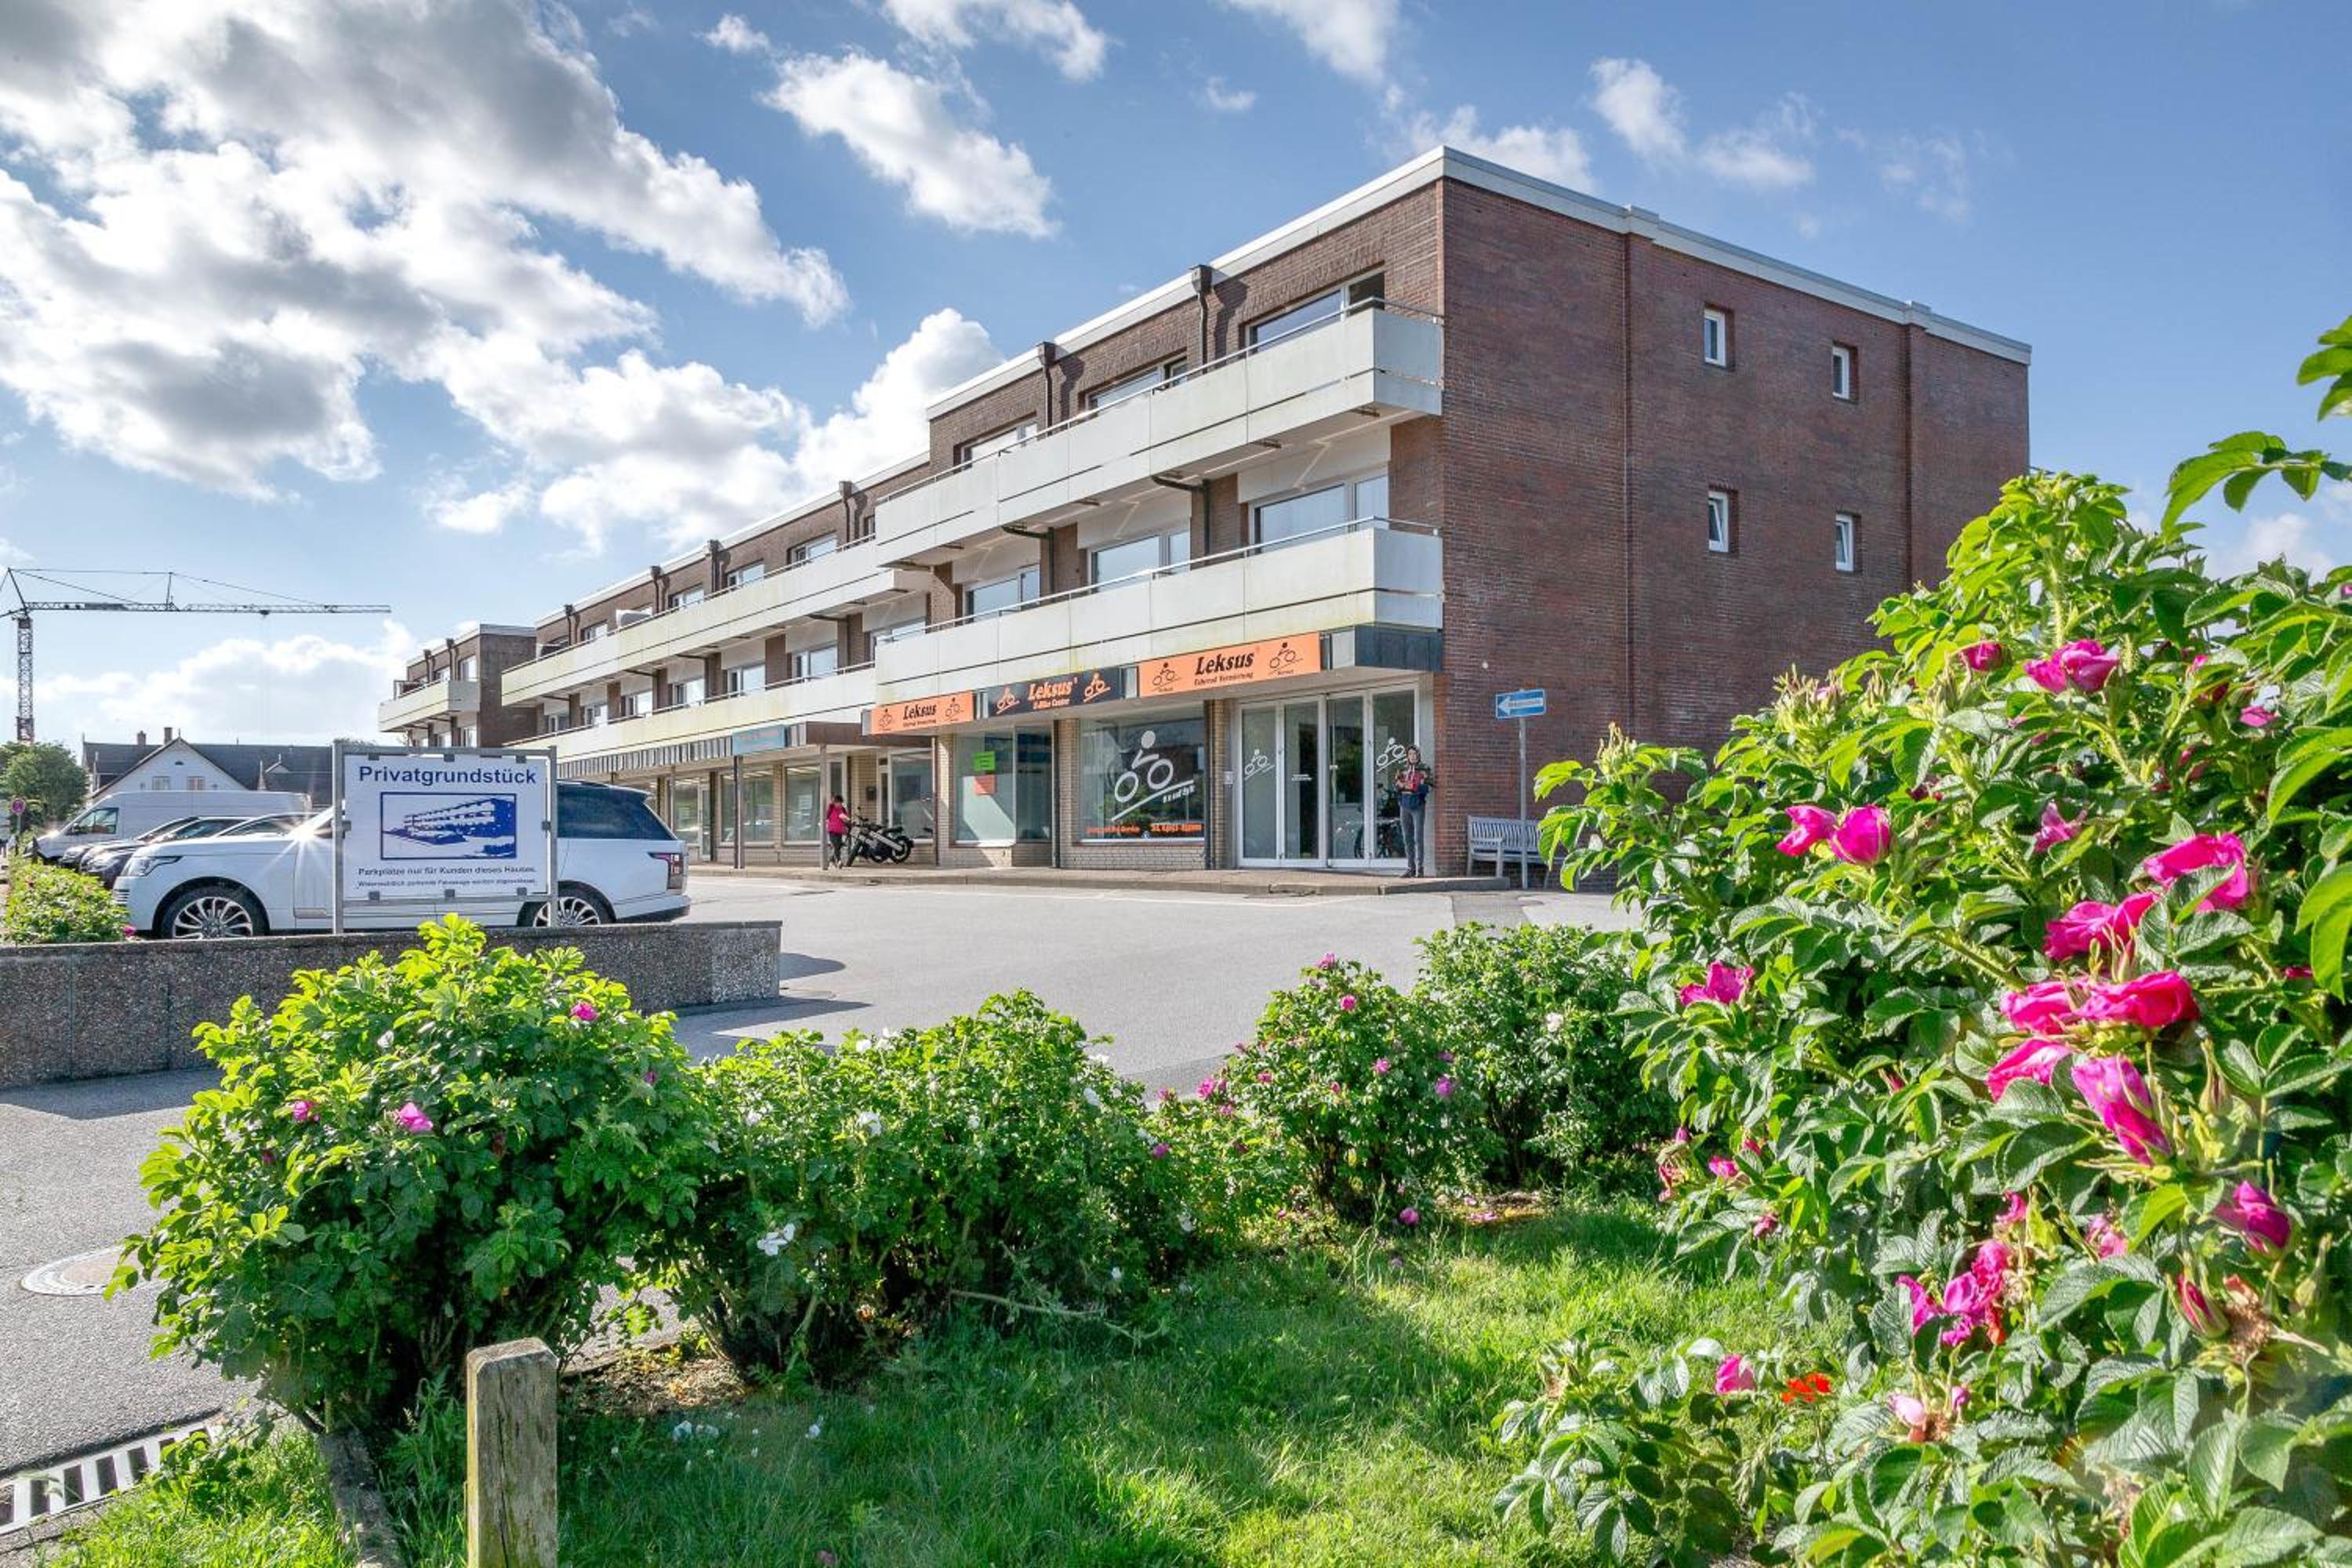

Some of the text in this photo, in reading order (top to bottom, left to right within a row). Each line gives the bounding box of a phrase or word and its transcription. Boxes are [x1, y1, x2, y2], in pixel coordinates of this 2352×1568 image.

[1194, 652, 1254, 675] Leksus
[1028, 681, 1073, 701] Leksus
[902, 704, 937, 720] Leksus
[359, 765, 537, 786] Privatgrundstück
[439, 866, 473, 874] Kunden
